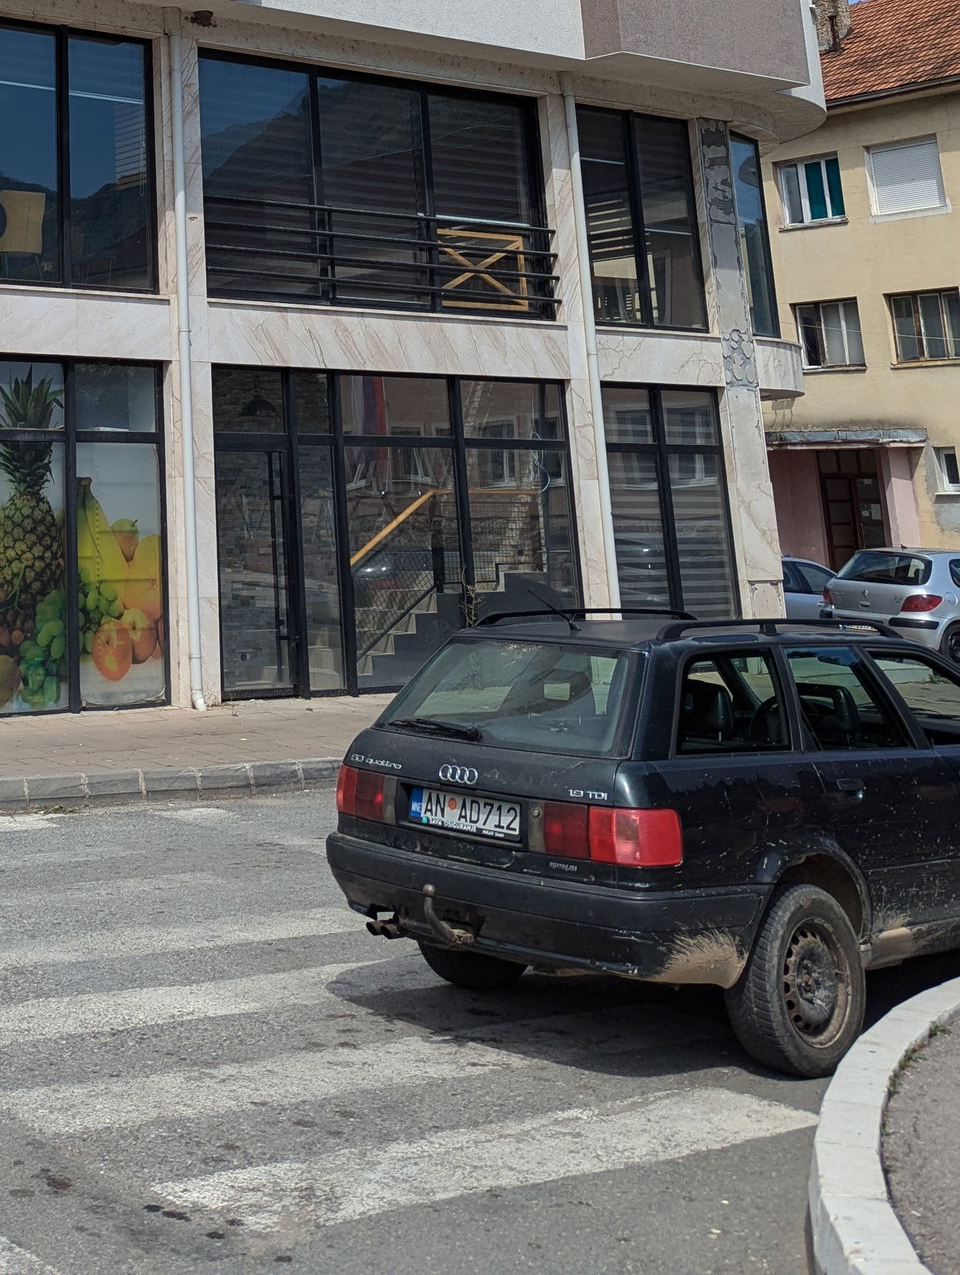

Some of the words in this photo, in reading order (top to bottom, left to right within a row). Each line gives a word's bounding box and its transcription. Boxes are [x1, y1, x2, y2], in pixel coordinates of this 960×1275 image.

[586, 791, 608, 801] TDI
[424, 792, 447, 818] AN
[458, 798, 519, 832] AD712
